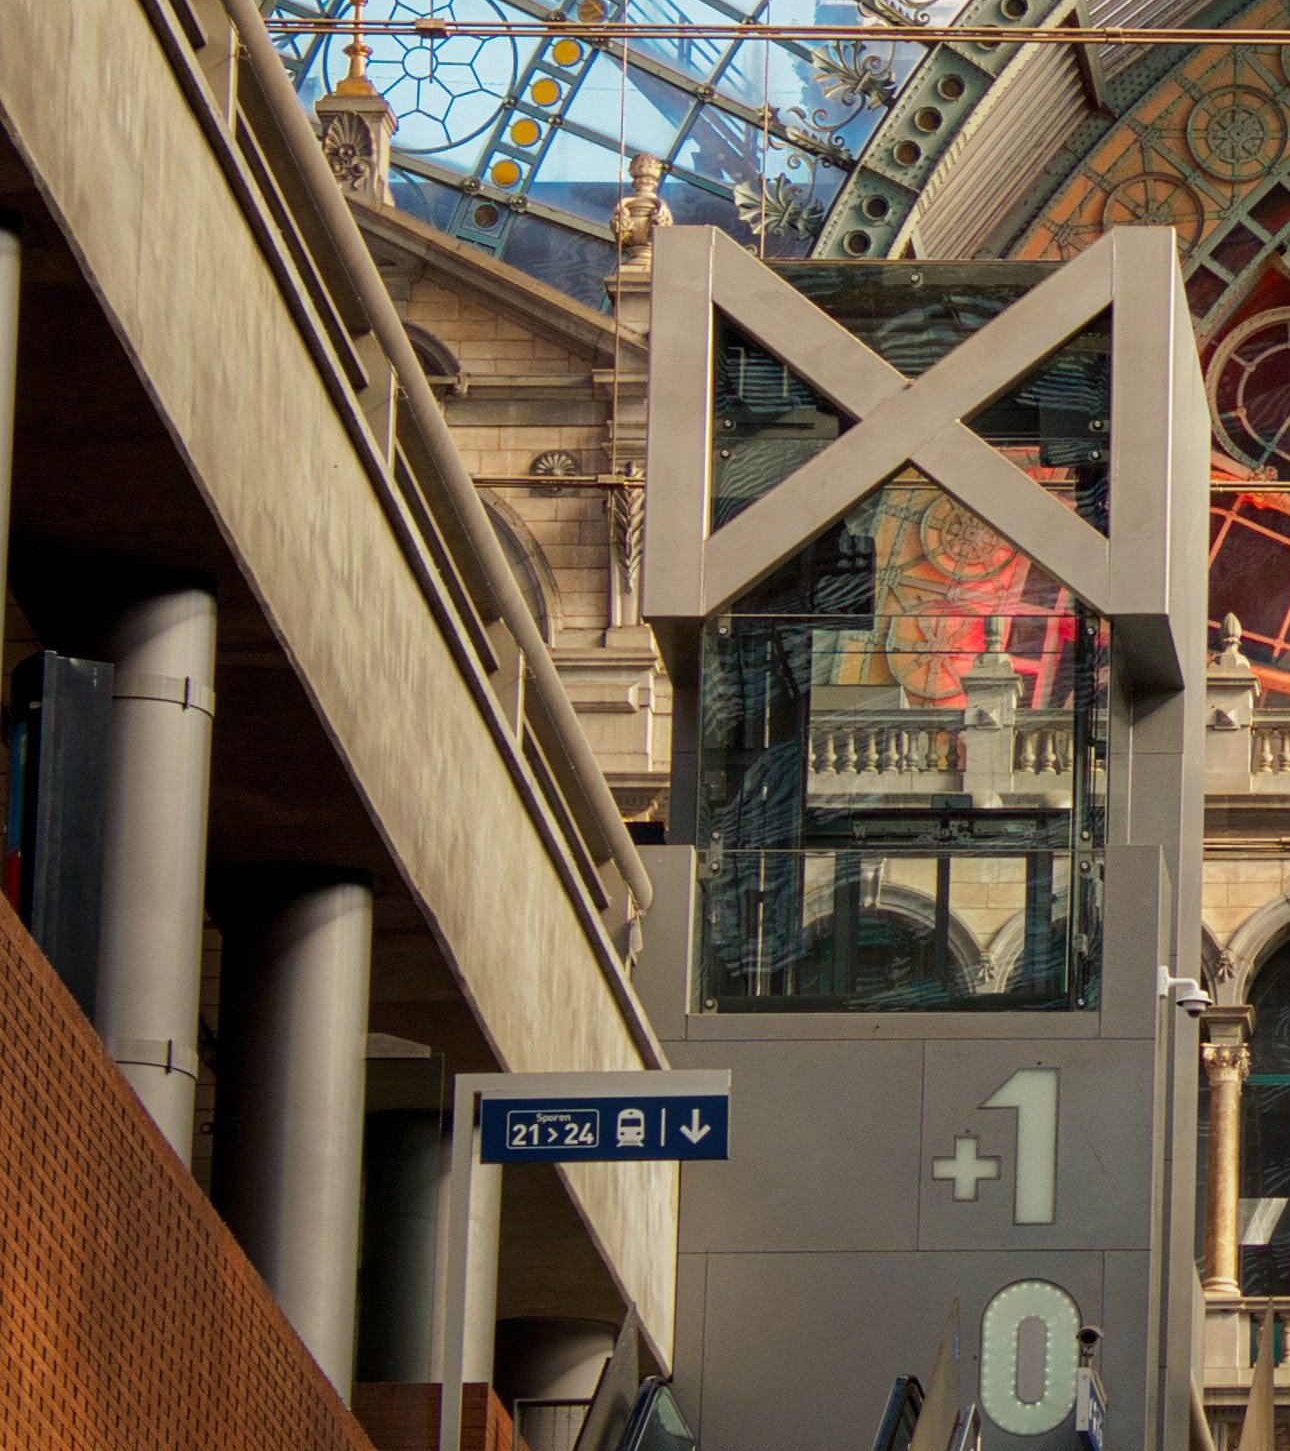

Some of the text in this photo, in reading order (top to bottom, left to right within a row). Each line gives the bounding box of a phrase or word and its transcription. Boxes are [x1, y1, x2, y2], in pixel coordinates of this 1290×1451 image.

[512, 1122, 595, 1146] 21 24
[536, 1113, 572, 1124] Sporen
[931, 1067, 1061, 1226] +1
[979, 1277, 1083, 1436] 0
